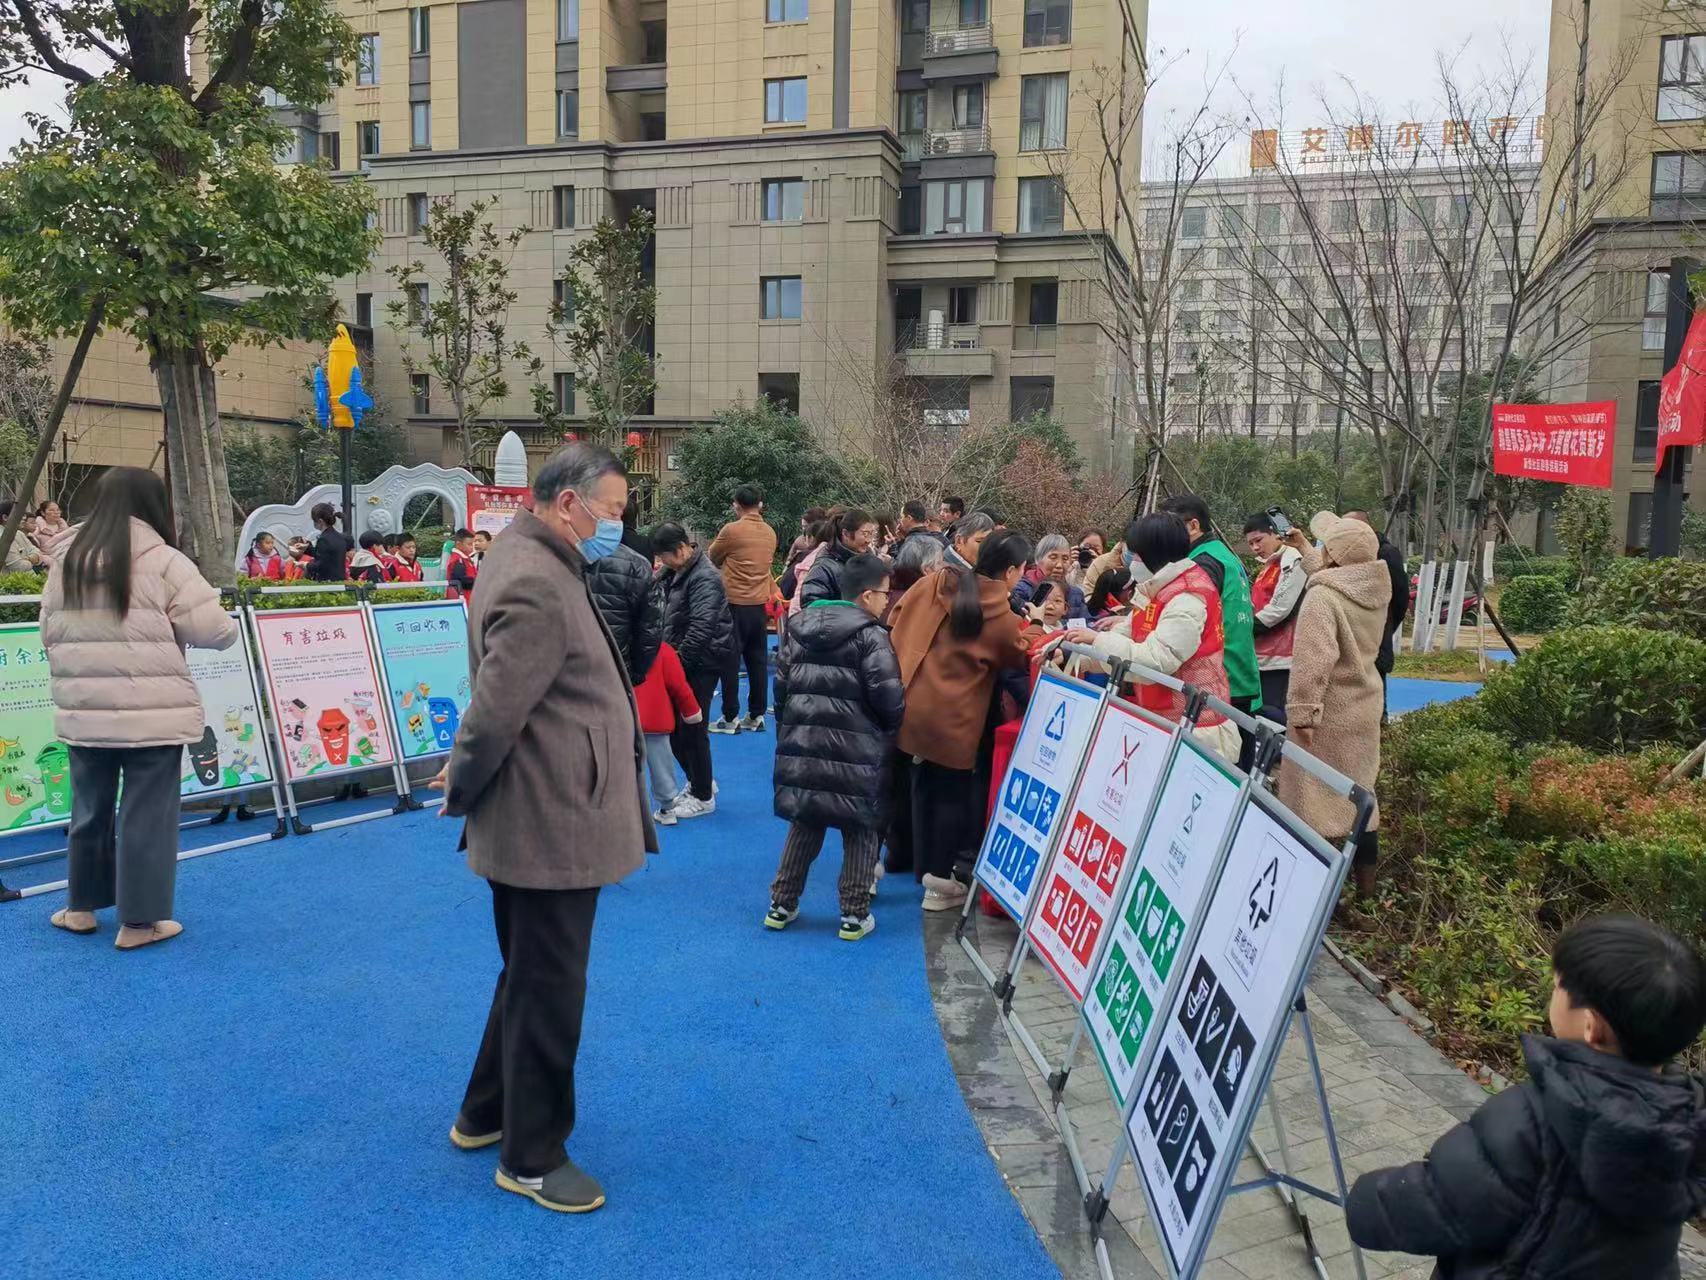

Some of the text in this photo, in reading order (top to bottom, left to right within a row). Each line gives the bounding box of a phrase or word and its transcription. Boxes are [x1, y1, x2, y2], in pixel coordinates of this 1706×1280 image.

[394, 619, 450, 634] 可回收物
[282, 628, 347, 646] 有害垃圾
